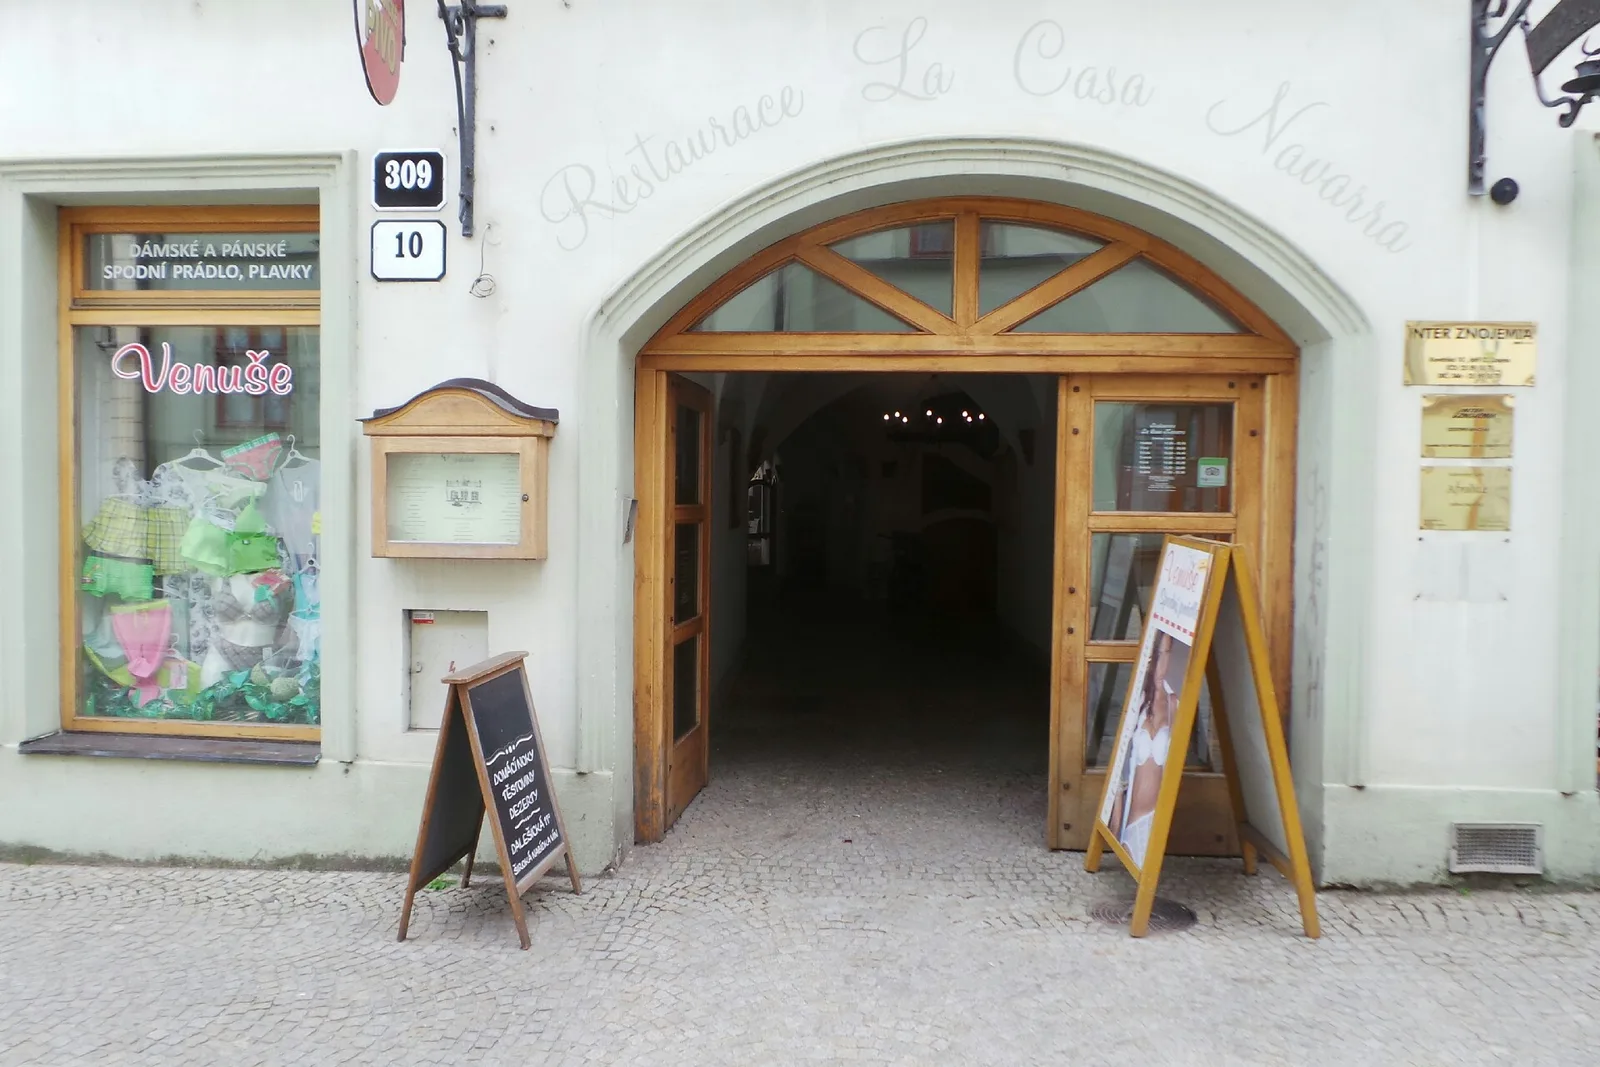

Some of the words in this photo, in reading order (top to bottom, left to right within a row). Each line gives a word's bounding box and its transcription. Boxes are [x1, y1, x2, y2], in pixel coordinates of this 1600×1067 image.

[539, 85, 804, 251] Restaurace
[853, 16, 955, 102] La
[1013, 19, 1155, 108] Casa
[1205, 80, 1412, 253] Navarra
[384, 158, 432, 190] 309
[130, 239, 199, 258] DÁMSKÉ
[204, 243, 217, 257] A
[221, 239, 286, 258] PÁNSKÉ
[394, 230, 424, 259] 10
[103, 261, 166, 279] SPODNÍ
[173, 261, 243, 281] PRÁDLO,
[249, 264, 312, 279] PLAVKY
[1456, 327, 1534, 340] ZNOJEMIA
[111, 342, 293, 395] Venuše
[516, 749, 535, 769] NOKY
[501, 769, 536, 802] TĚSTOVINY
[508, 788, 539, 821] DEZERTY
